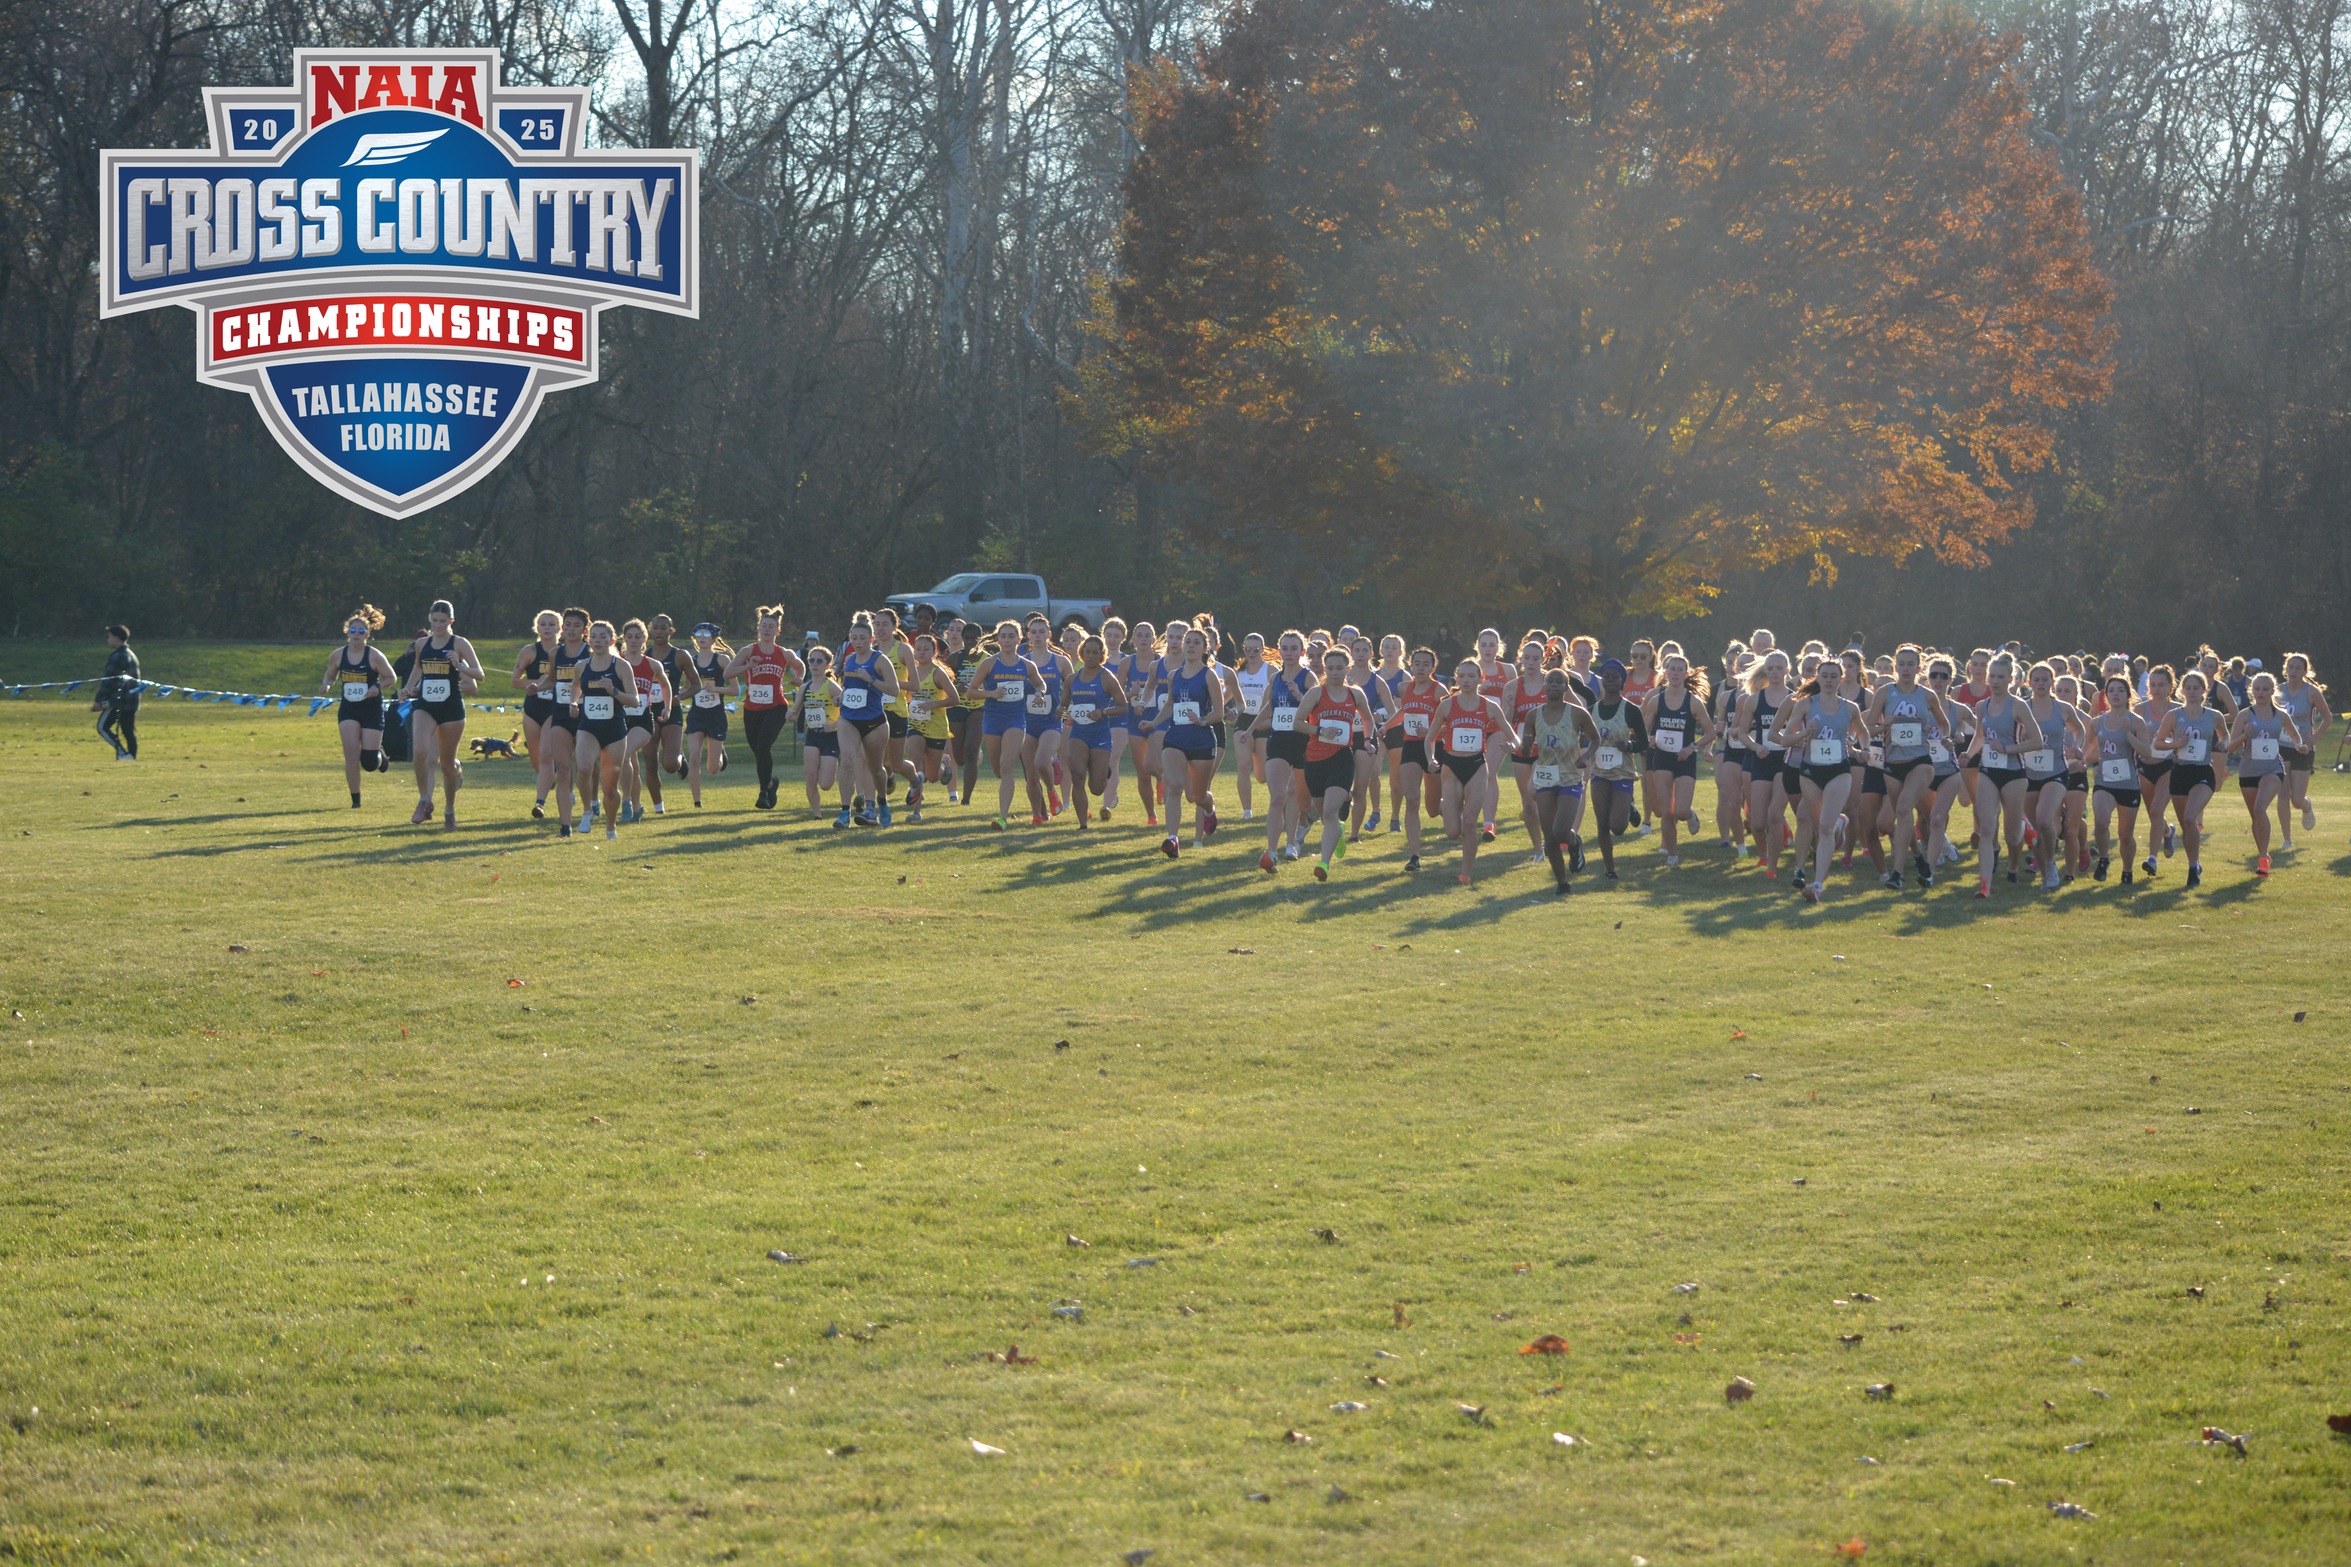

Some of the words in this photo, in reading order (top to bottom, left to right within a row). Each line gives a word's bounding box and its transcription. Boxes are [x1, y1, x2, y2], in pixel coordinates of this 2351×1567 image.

[347, 687, 364, 696] 248
[426, 686, 446, 695] 249
[752, 690, 769, 698] 236
[1003, 687, 1019, 695] 202
[700, 694, 716, 703] 253
[846, 694, 862, 703] 200
[588, 703, 609, 712] 244
[1892, 700, 1920, 719] AQ
[808, 713, 821, 722] 218
[1277, 714, 1293, 723] 168
[1659, 717, 1686, 725] GOLDEN
[1450, 717, 1473, 728] INDIANA
[1473, 719, 1486, 729] TECH
[1900, 730, 1914, 739] 20
[1460, 735, 1476, 744] 137
[1663, 736, 1675, 745] 73
[1820, 747, 1831, 756] 14
[2188, 745, 2195, 753] 2
[2262, 745, 2269, 753] 6
[1601, 753, 1614, 763] 117
[1989, 751, 1998, 760] 10
[2034, 755, 2043, 764] 17
[2112, 766, 2119, 775] 8
[1536, 770, 1552, 781] 122
